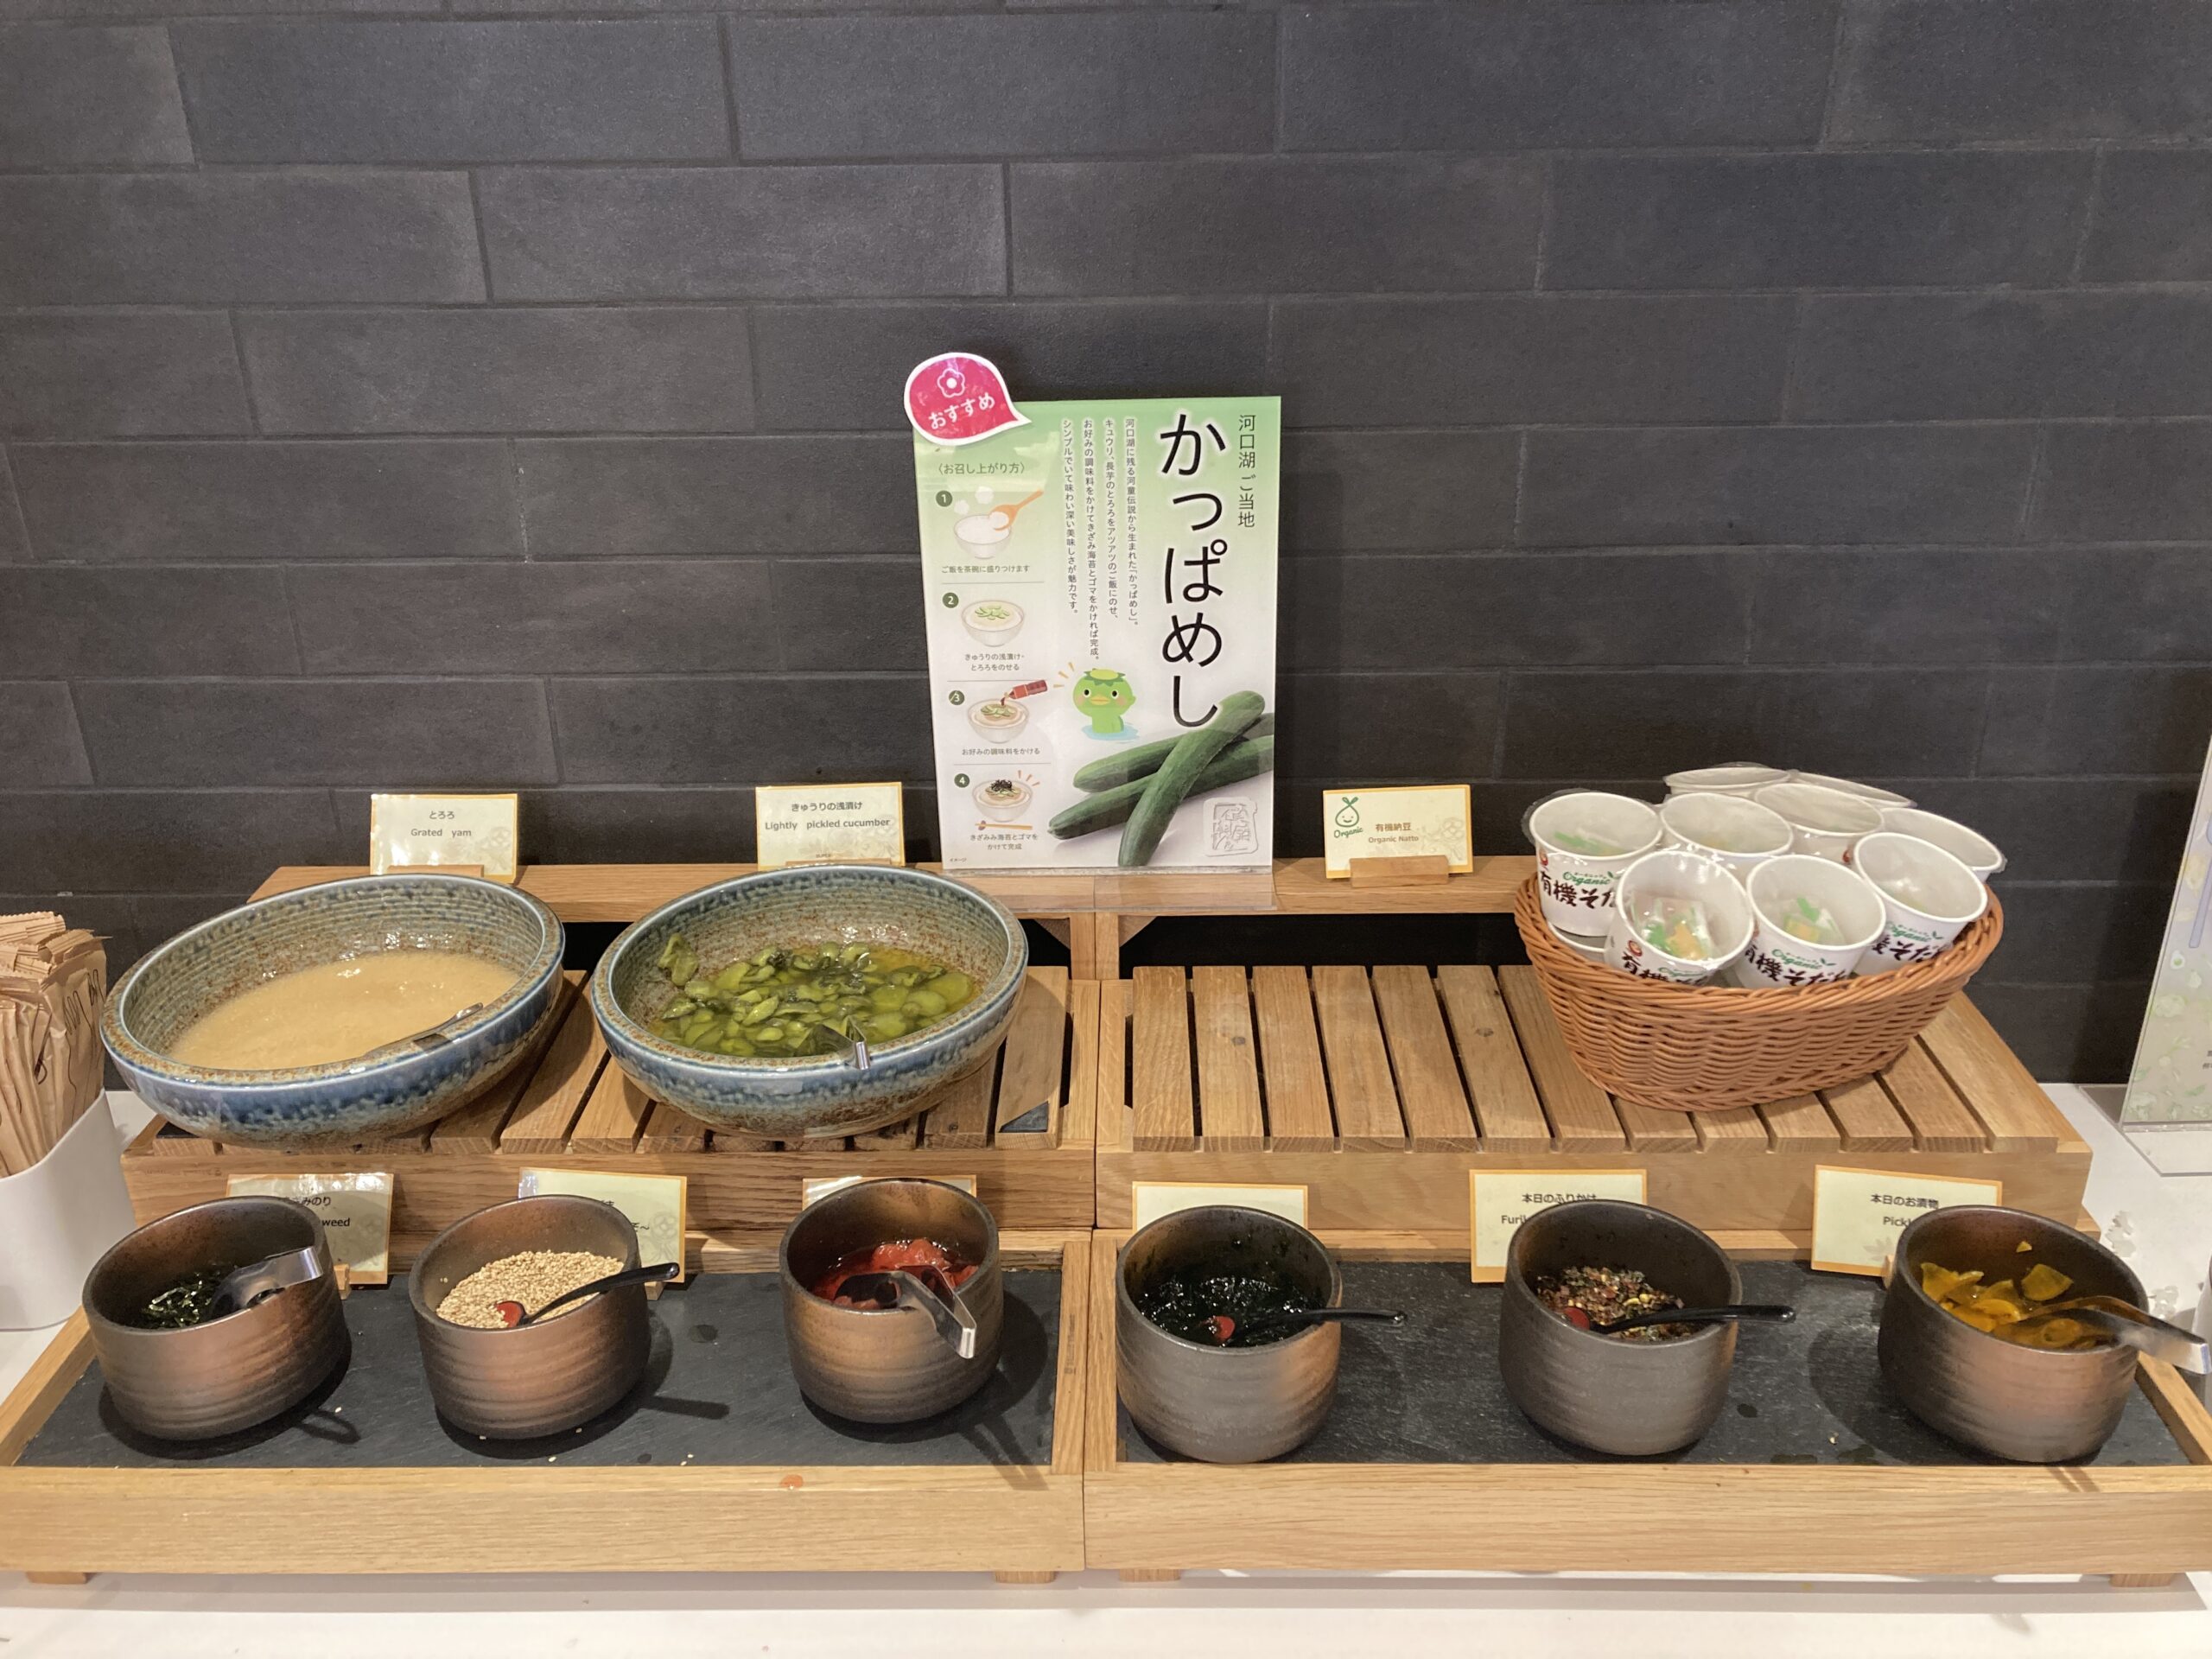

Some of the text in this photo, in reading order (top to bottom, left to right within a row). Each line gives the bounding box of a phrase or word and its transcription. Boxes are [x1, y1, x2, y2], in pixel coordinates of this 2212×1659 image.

[929, 392, 995, 429] おすすめ
[1160, 414, 1228, 728] かっぱめし
[791, 802, 862, 811] きゅうりの浅漬け
[429, 810, 455, 820] とろろ
[765, 818, 891, 831] Lightly pickled cucumber
[1376, 823, 1412, 832] 有機納豆
[1333, 827, 1363, 838] Organic
[1562, 871, 1610, 886] Organic
